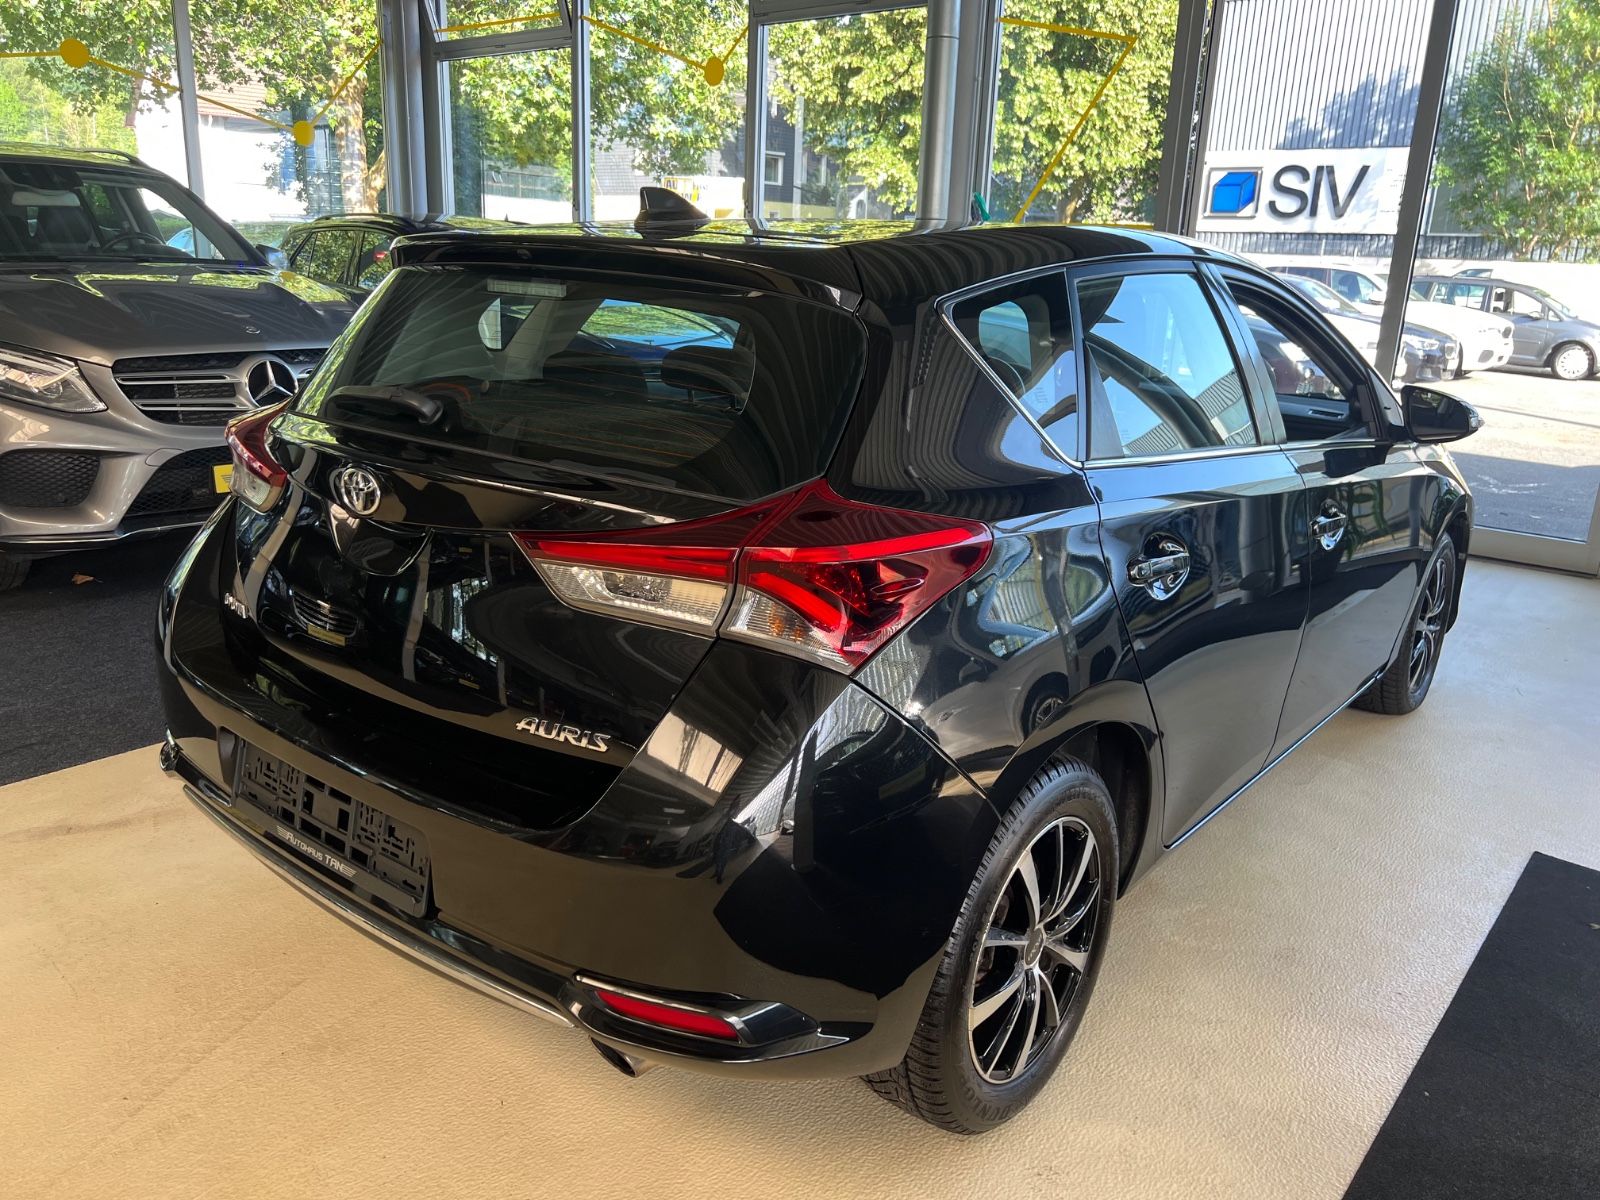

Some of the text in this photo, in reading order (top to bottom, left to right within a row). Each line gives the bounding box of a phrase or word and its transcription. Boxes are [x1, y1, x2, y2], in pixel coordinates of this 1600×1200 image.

[1268, 164, 1371, 218] SIV
[515, 717, 611, 752] AURIS
[324, 854, 344, 873] TAN
